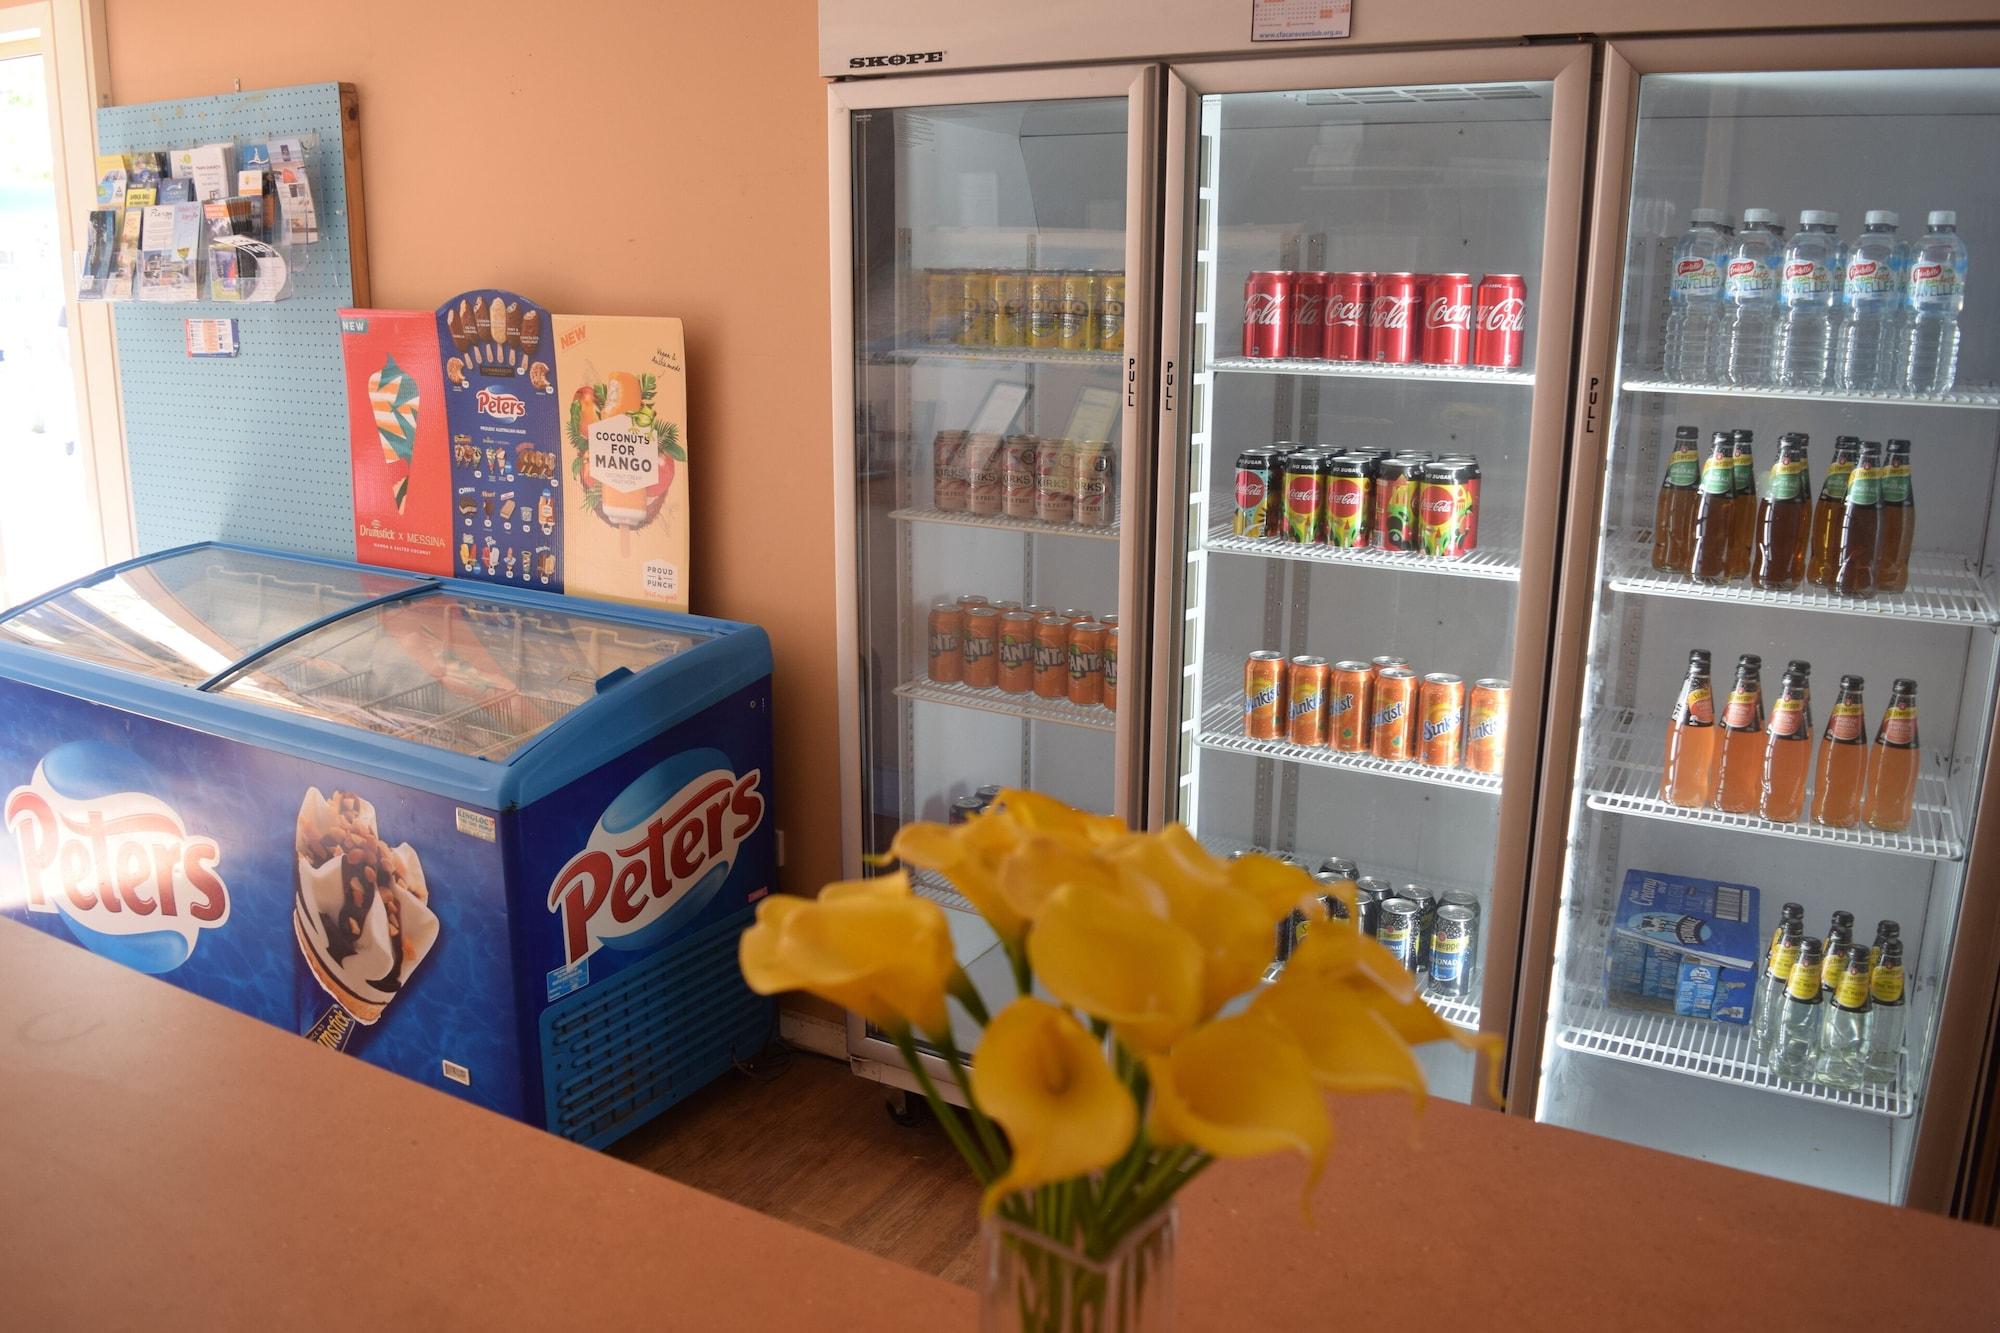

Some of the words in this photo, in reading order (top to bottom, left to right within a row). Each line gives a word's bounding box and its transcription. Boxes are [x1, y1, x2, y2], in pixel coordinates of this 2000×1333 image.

[849, 51, 943, 69] SKOPE
[341, 320, 364, 331] NEW
[560, 325, 587, 350] NEW
[477, 391, 525, 416] Peters
[1587, 378, 1598, 432] PULL
[596, 432, 650, 445] COCONUTS
[611, 444, 635, 456] FOR
[595, 454, 652, 472] MANGO
[360, 524, 396, 541] Drumstick
[406, 533, 446, 548] MESSINA
[647, 566, 673, 575] PROUD
[647, 580, 673, 589] PUNCH
[7, 790, 227, 922] Peters
[550, 772, 763, 965] Peters
